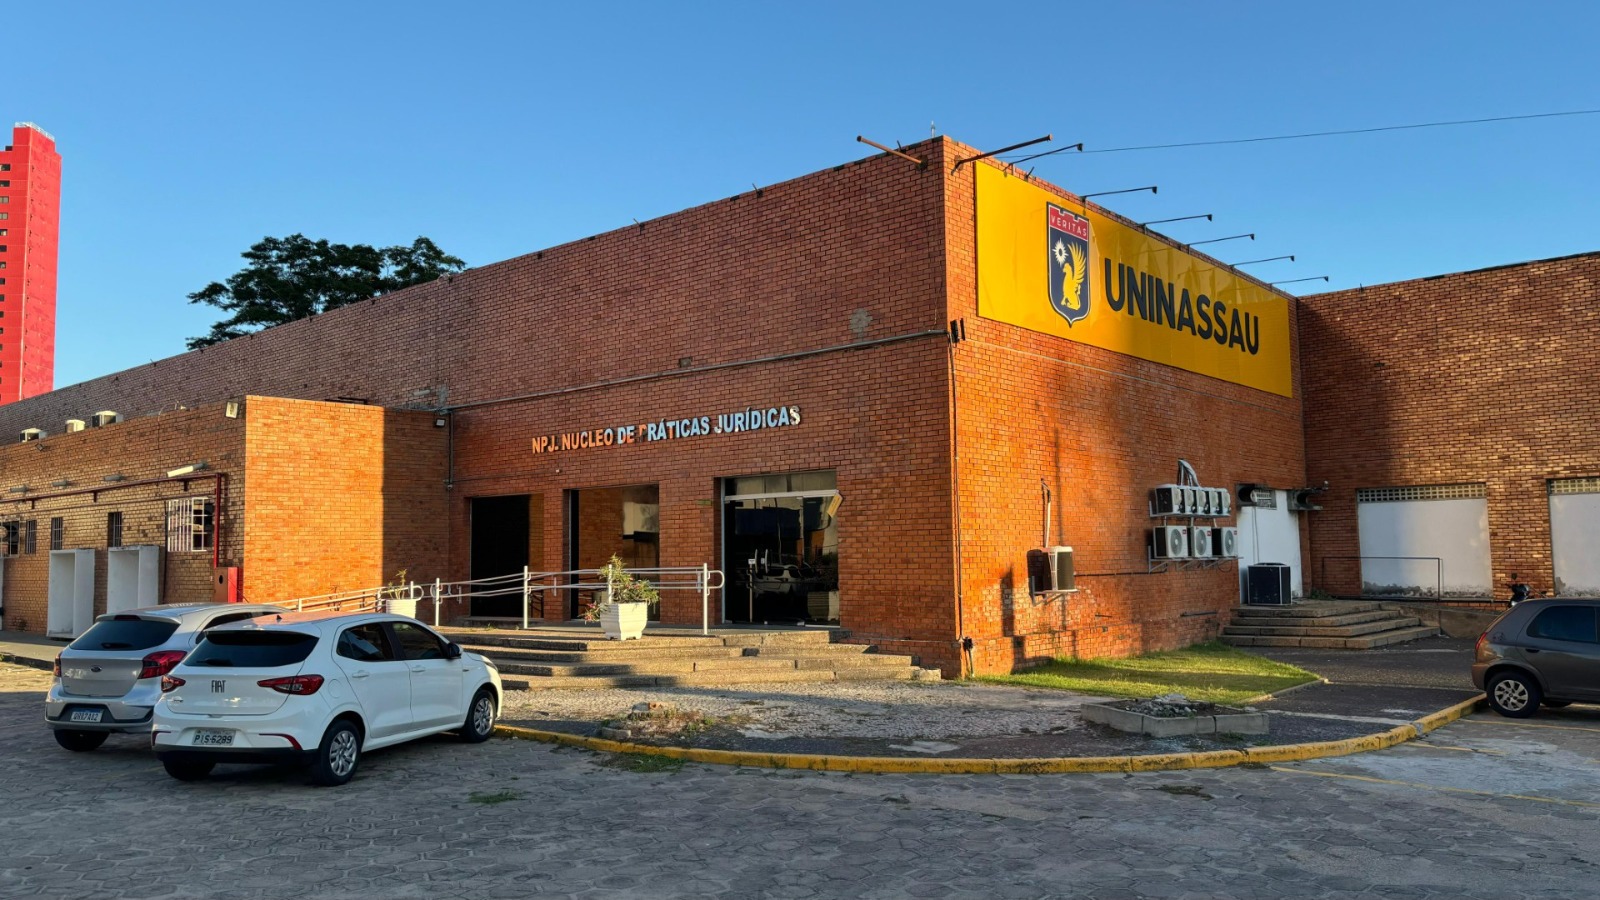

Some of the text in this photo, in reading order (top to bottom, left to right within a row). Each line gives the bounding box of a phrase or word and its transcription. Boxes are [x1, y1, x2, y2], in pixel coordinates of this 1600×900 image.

[1050, 214, 1087, 237] VERITAS
[1104, 257, 1260, 355] UNINASSAU
[531, 435, 559, 454] NPJ.
[561, 428, 614, 451] NUCLEO
[617, 425, 636, 445] DE
[713, 405, 802, 434] JURÍDICAS
[211, 679, 227, 694] FIAT
